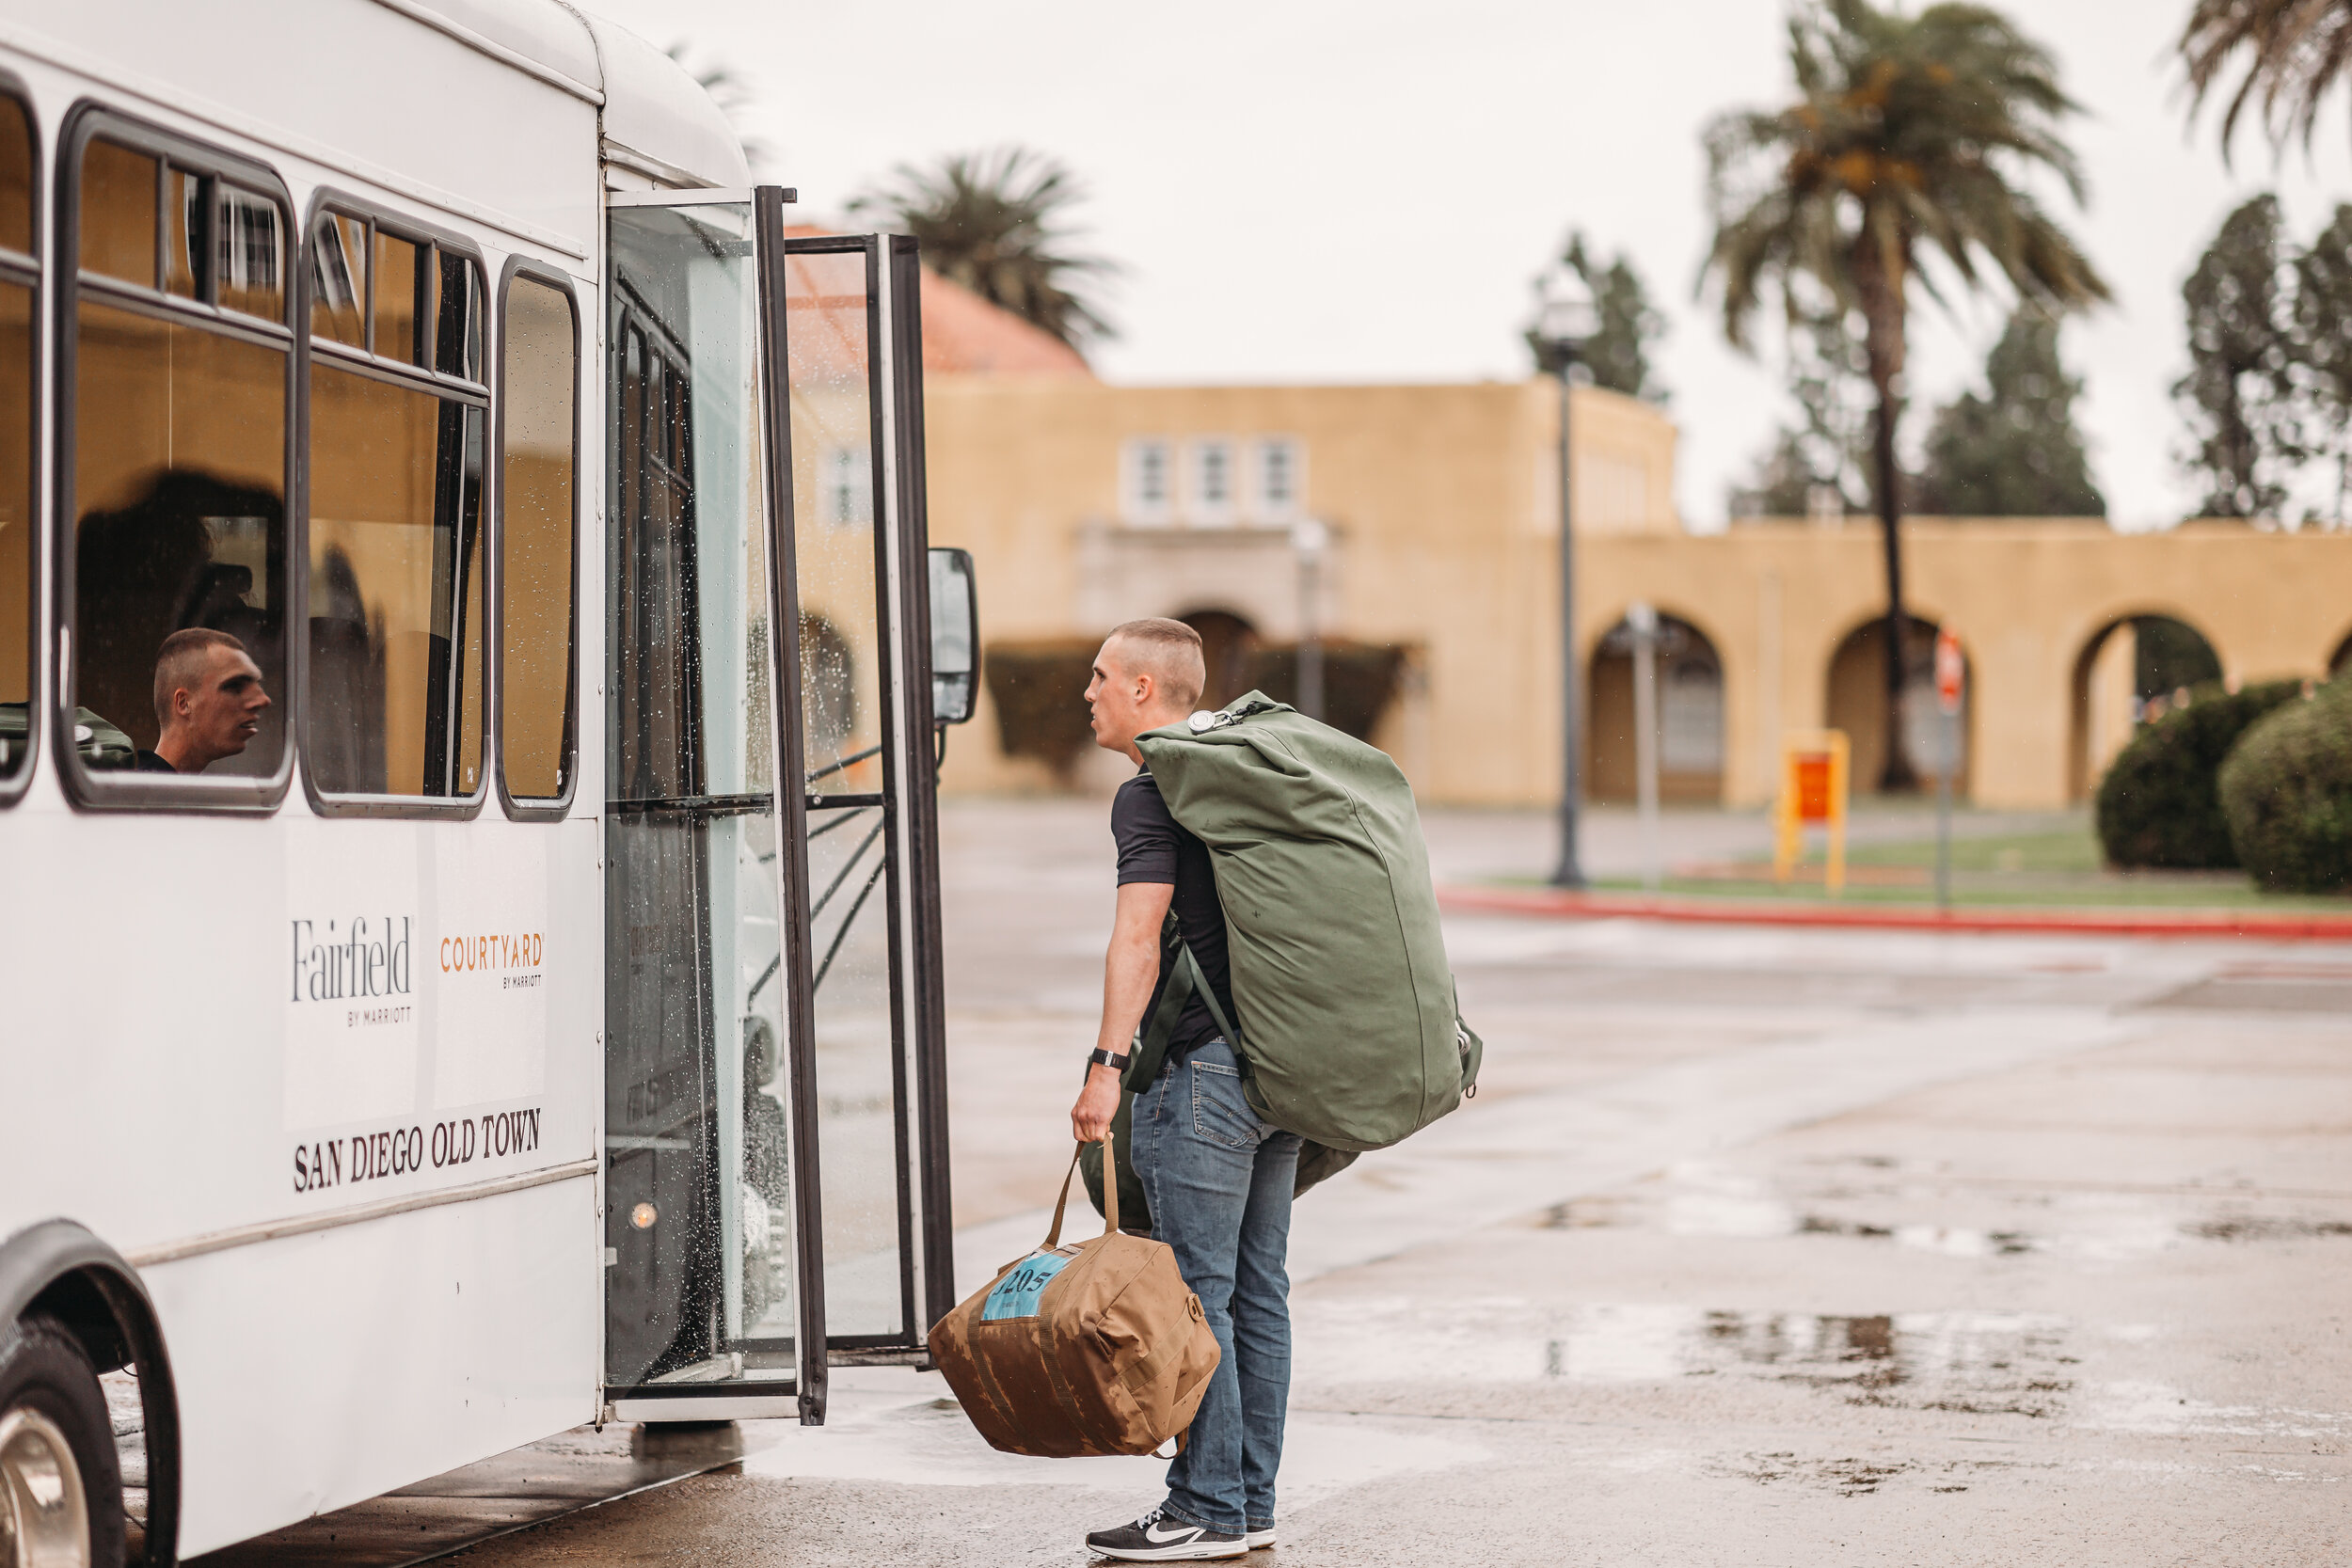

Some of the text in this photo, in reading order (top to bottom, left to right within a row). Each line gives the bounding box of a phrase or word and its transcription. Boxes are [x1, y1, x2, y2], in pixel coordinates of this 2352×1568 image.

[292, 916, 411, 1003] Fairfield
[440, 933, 542, 973] COURTYARD
[503, 974, 541, 990] BY MARRIOTT
[348, 1006, 410, 1027] BY MARRIOTT
[294, 1108, 541, 1193] SAN DIEGO OLD TOWN
